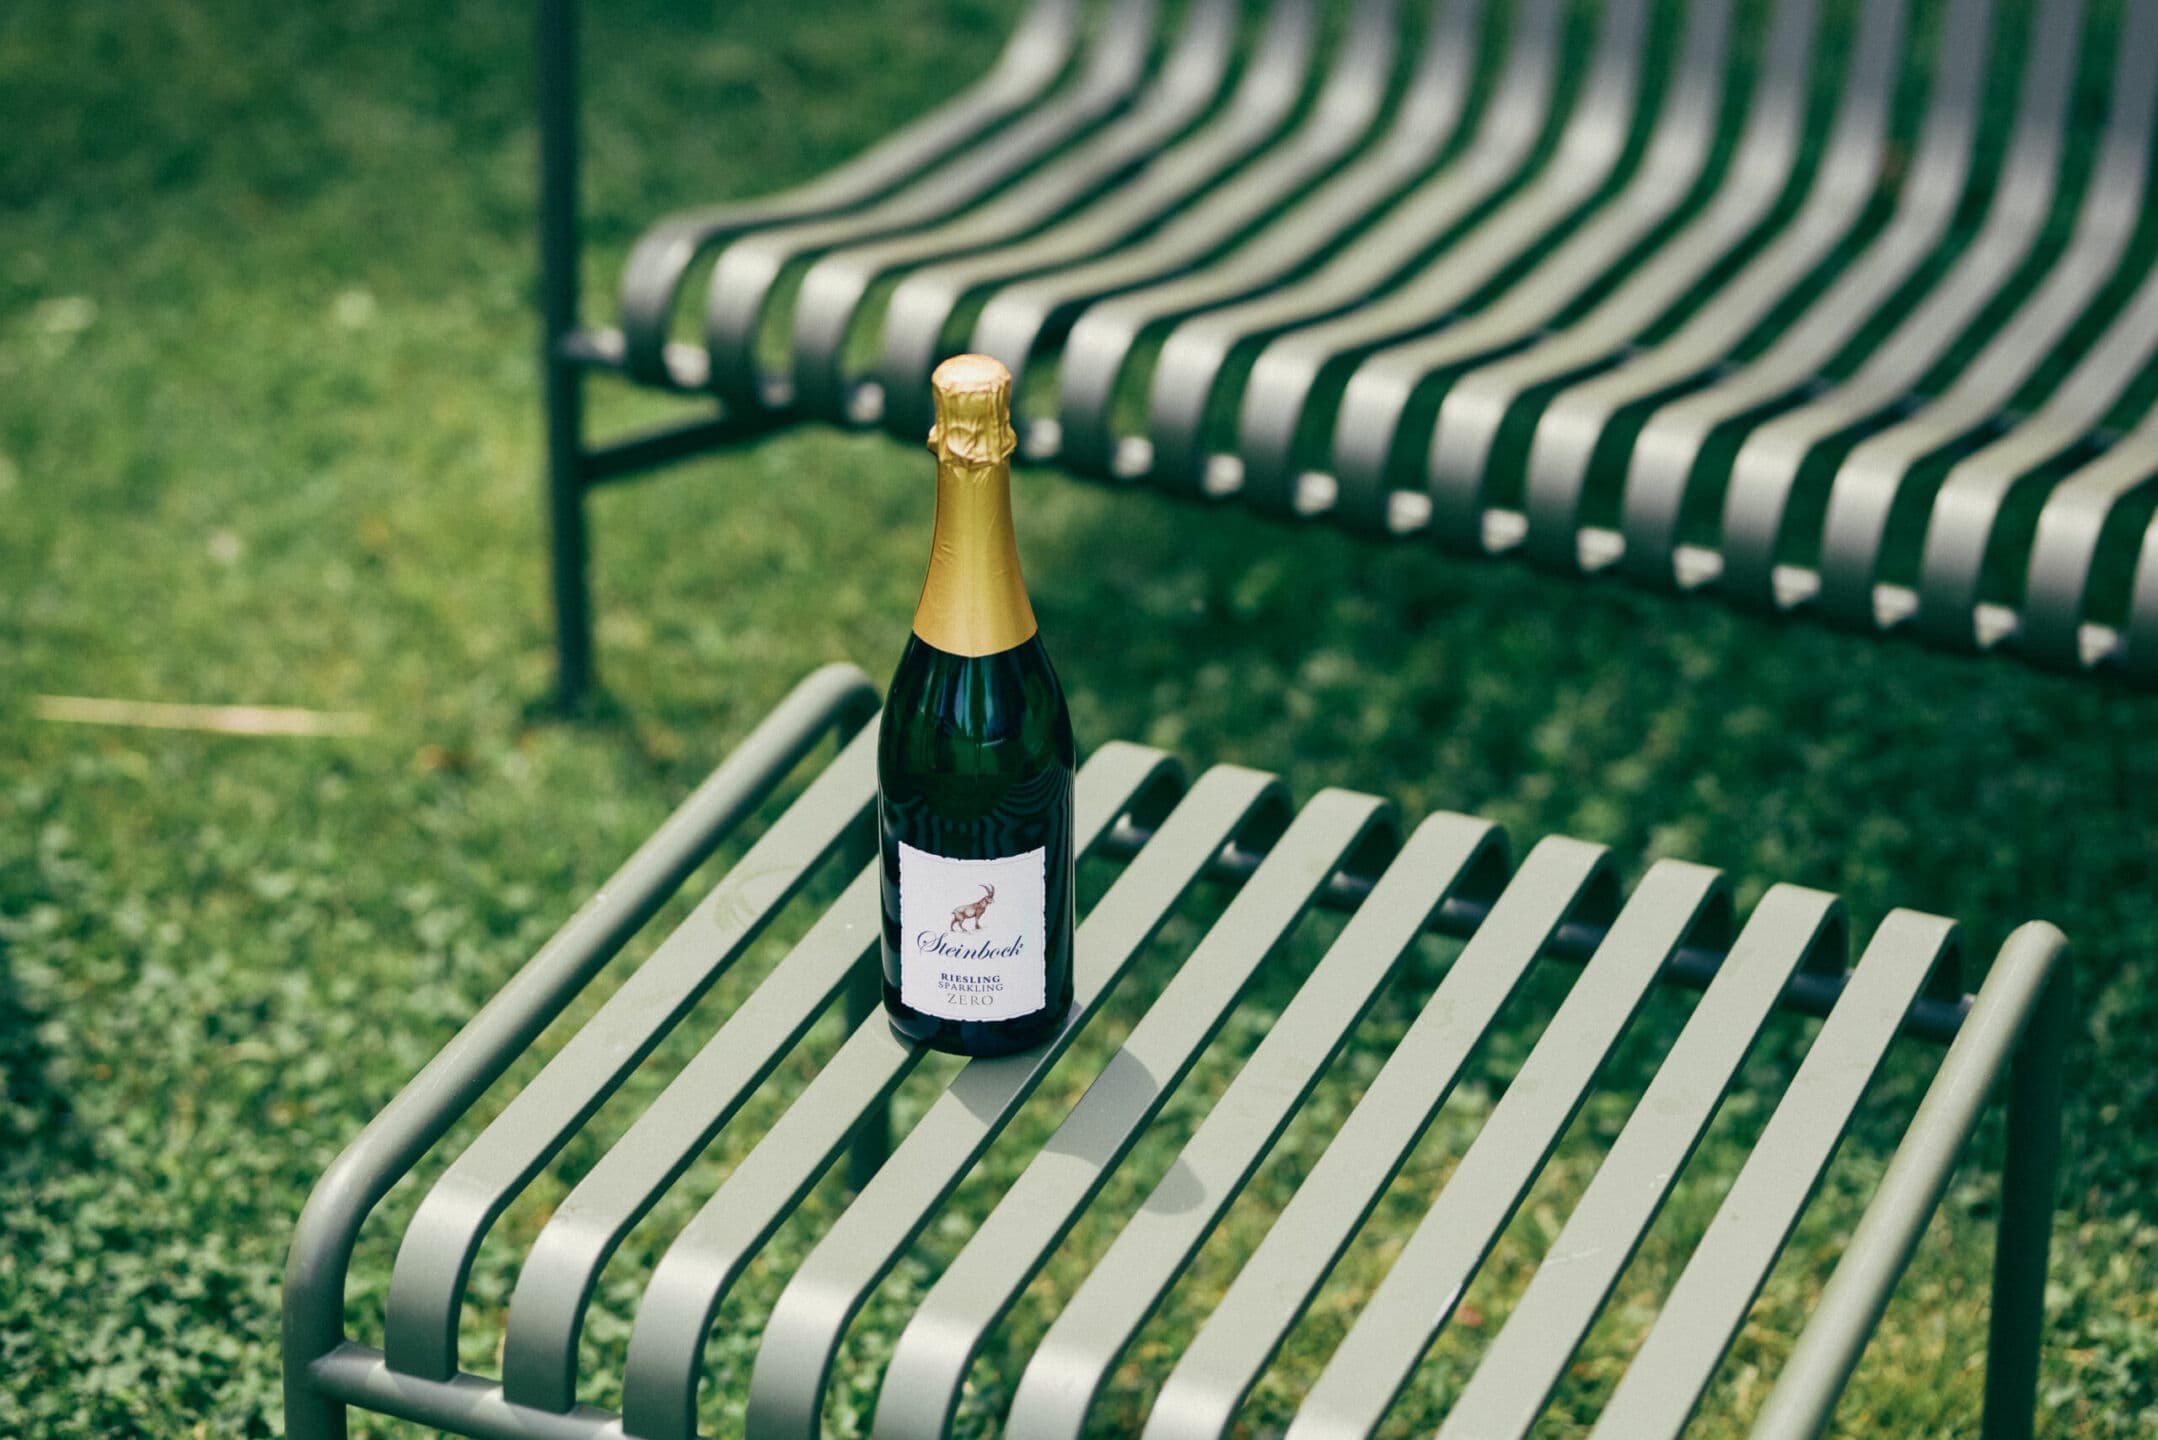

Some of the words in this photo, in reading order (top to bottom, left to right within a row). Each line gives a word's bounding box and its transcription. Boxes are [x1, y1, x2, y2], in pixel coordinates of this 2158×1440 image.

[917, 931, 1023, 960] Steinbock
[941, 973, 1000, 983] RIESLING
[938, 981, 1003, 992] SPARKLING
[947, 993, 994, 1006] ZERO
